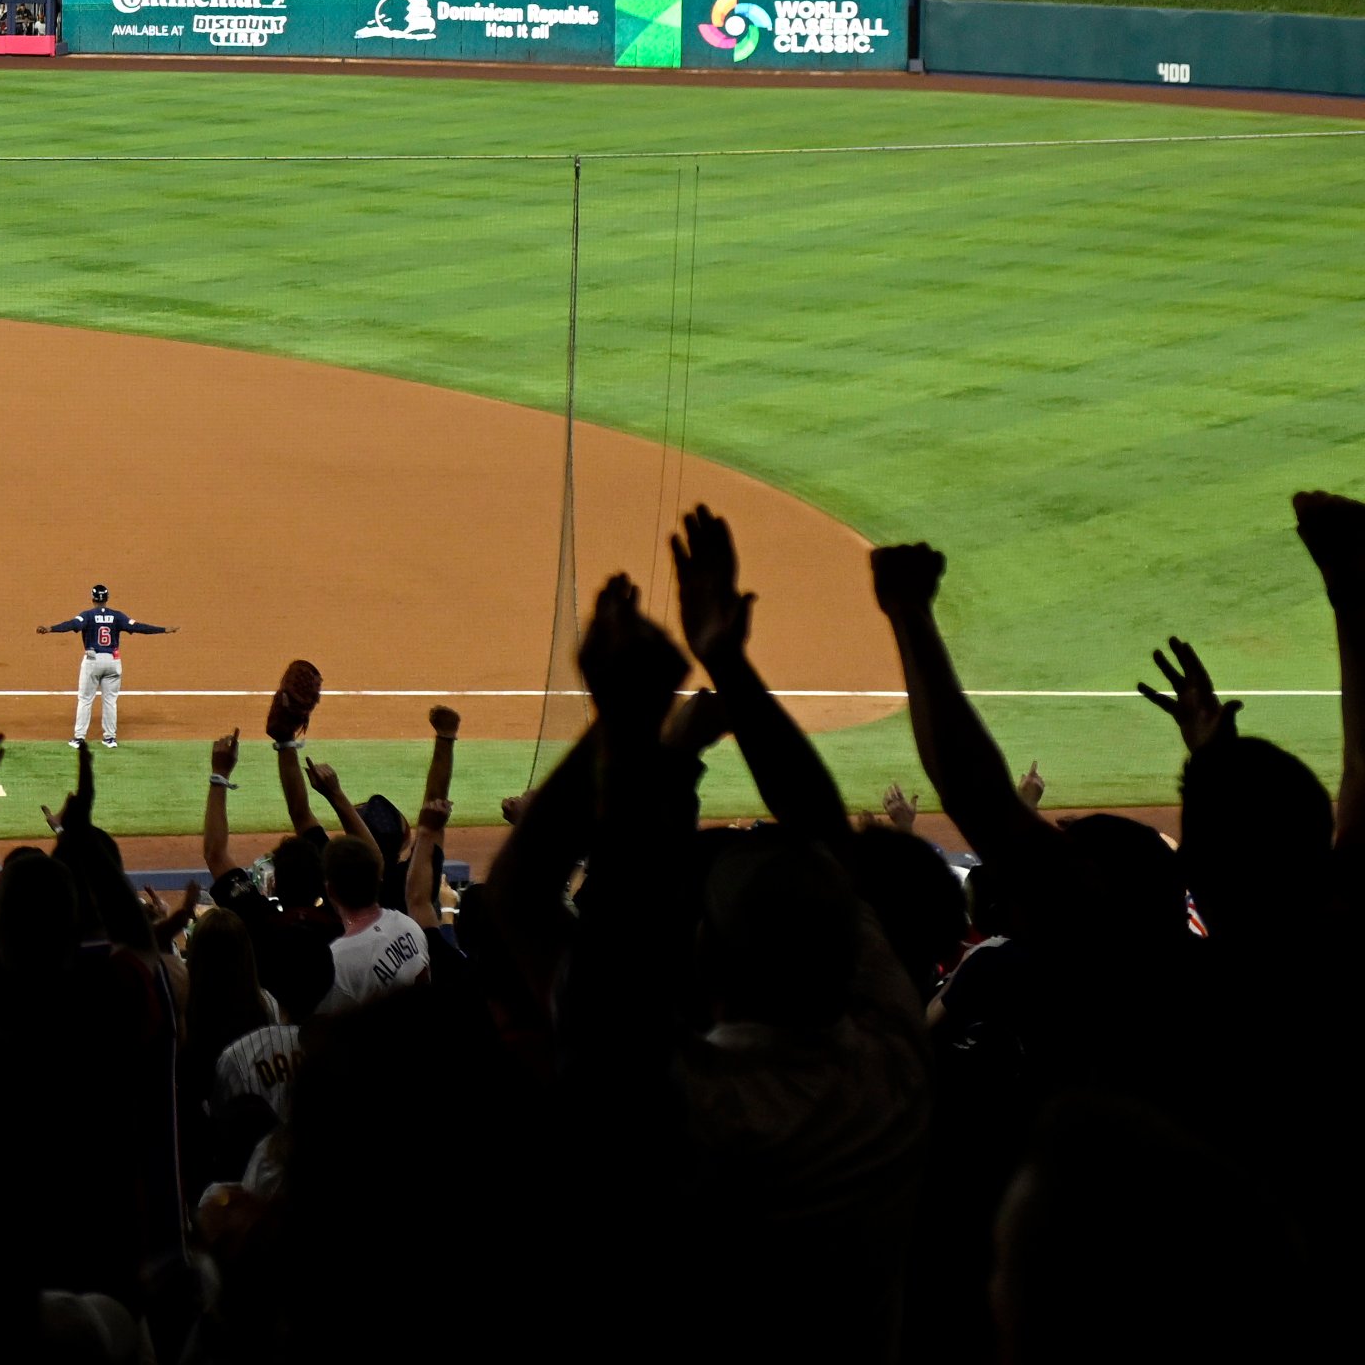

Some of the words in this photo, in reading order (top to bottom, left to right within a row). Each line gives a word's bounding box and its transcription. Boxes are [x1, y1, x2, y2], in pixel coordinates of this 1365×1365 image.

[438, 1, 523, 23] Dominican
[527, 4, 599, 26] Republic
[774, 0, 858, 17] WORLD
[112, 24, 164, 36] AVAILABLE
[167, 25, 185, 36] AT
[195, 17, 286, 32] DISCOUNT
[486, 24, 513, 38] Has
[531, 24, 549, 39] all
[774, 18, 889, 37] BASEBALL
[1157, 62, 1191, 84] 400
[98, 626, 111, 646] 6
[372, 932, 419, 986] ALONSO
